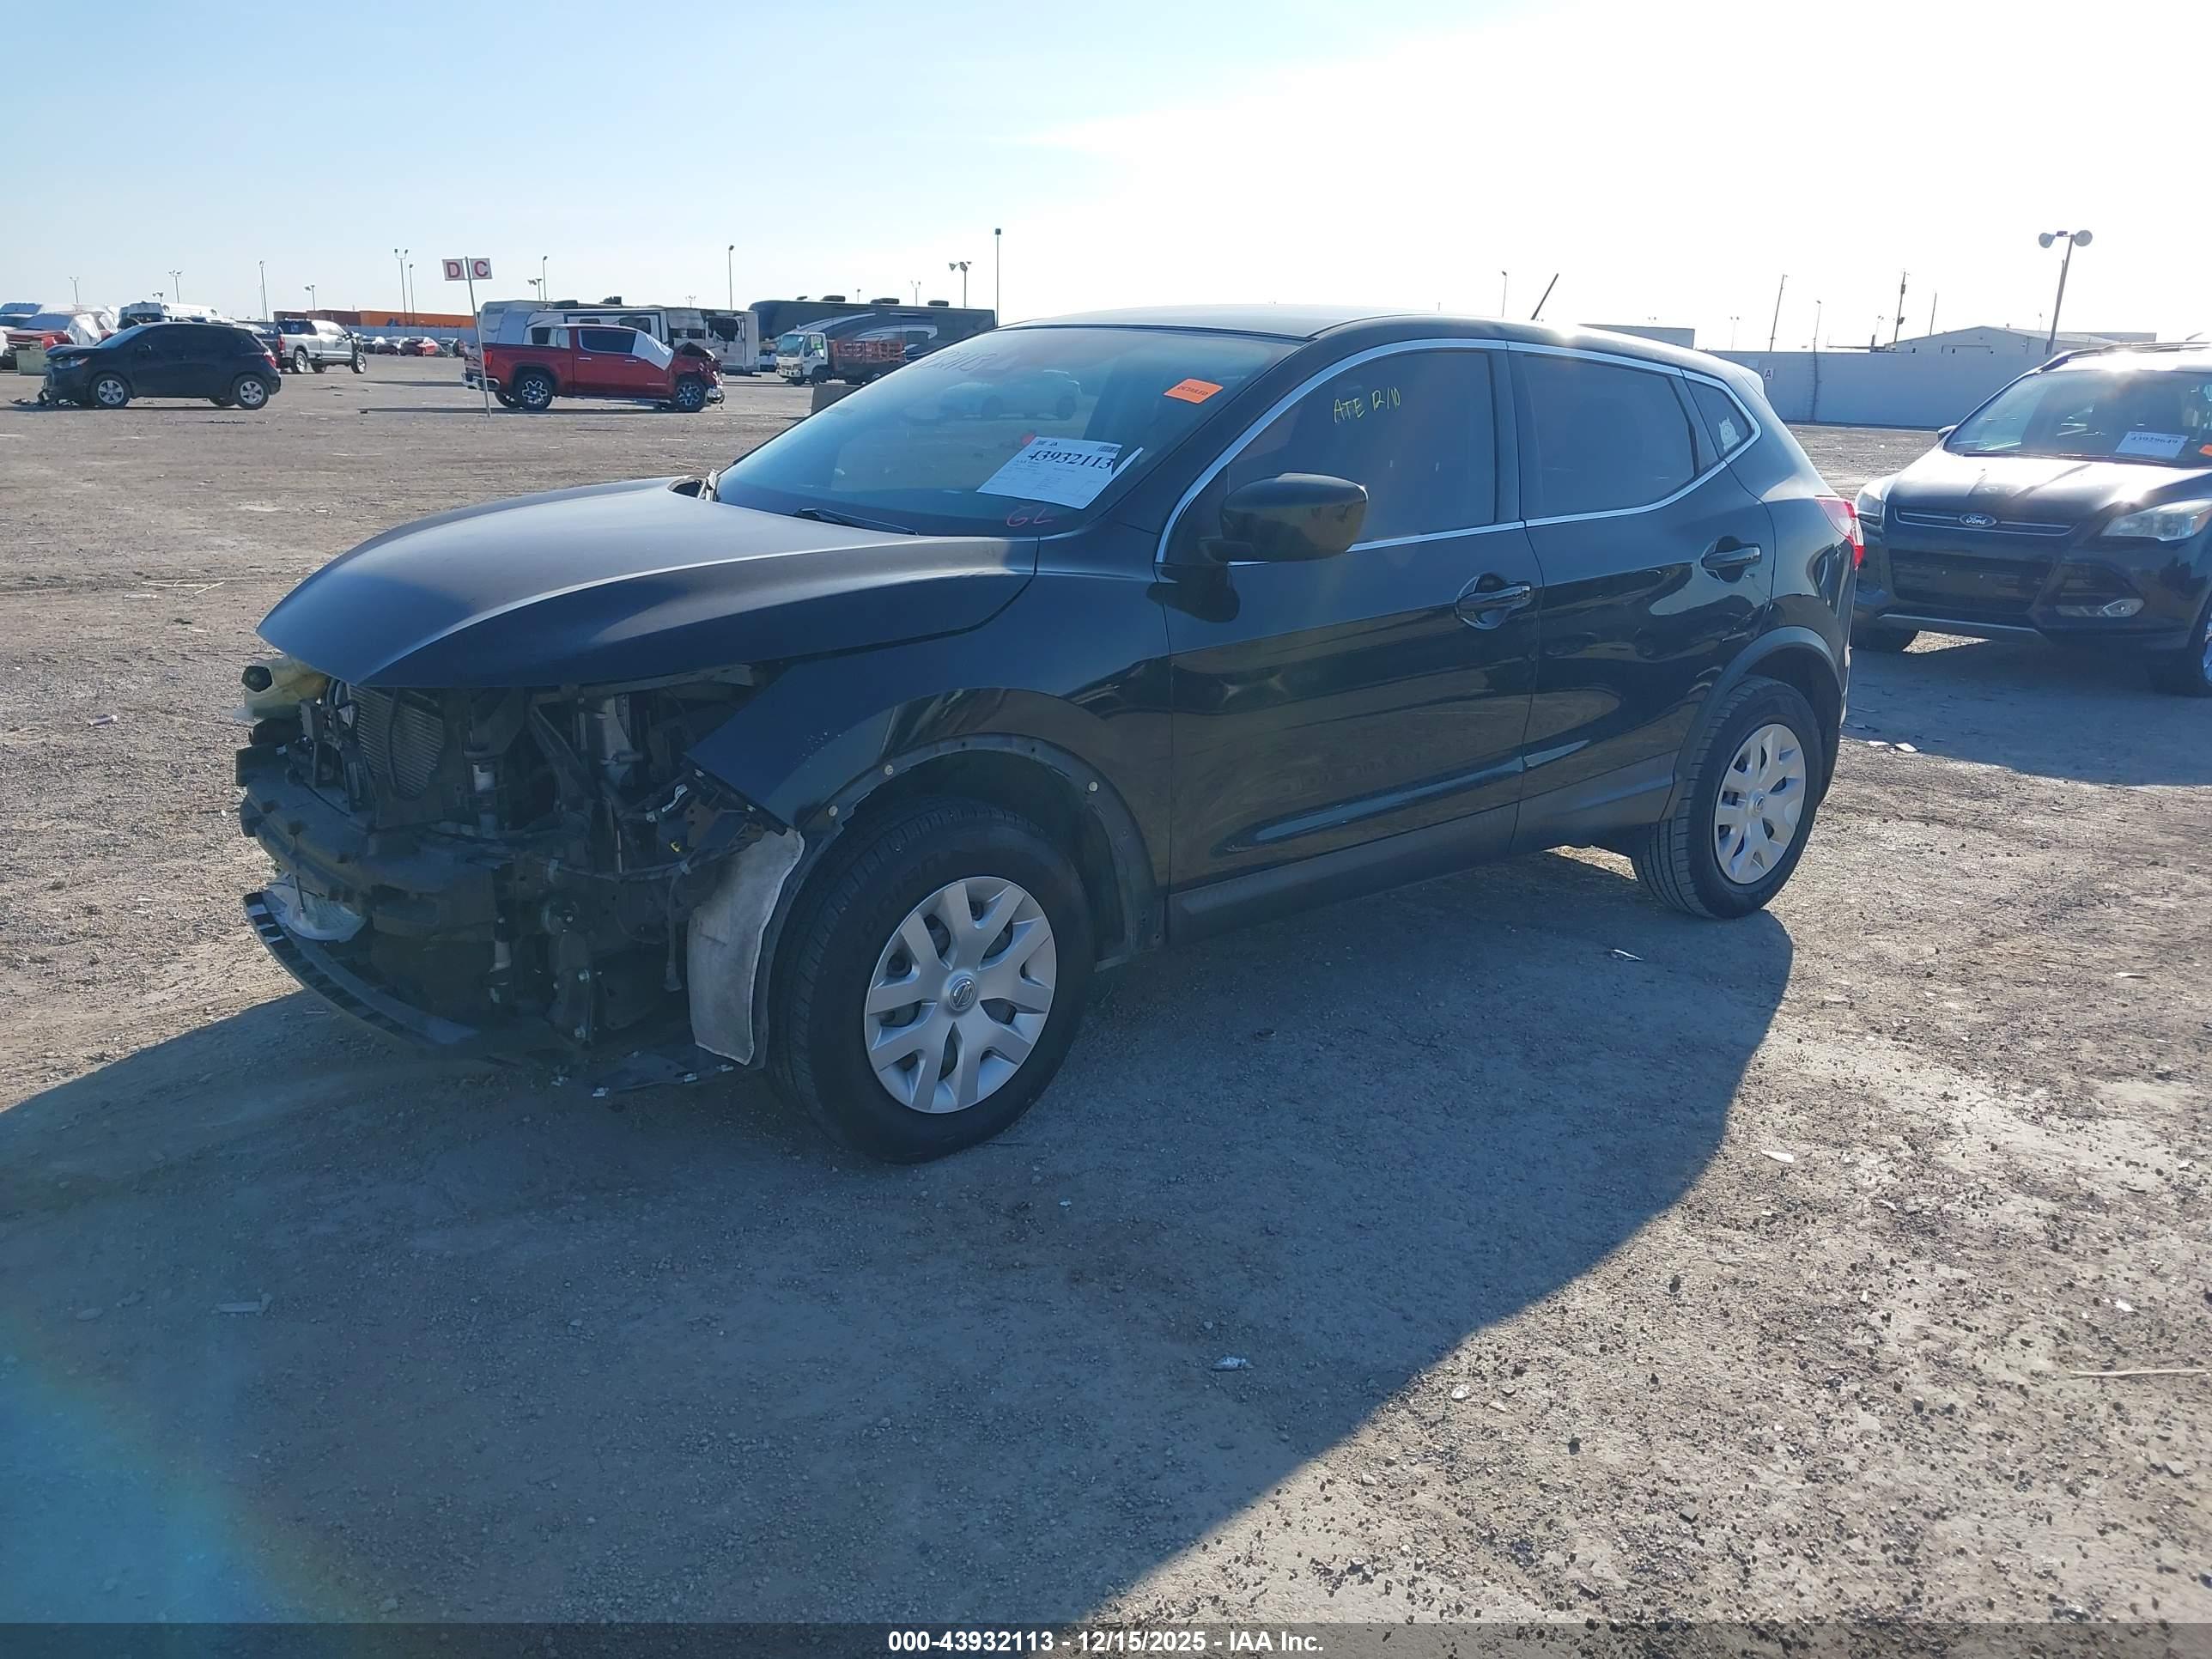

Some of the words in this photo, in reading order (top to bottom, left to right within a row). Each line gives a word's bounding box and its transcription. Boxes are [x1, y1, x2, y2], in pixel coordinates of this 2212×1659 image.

[447, 261, 461, 278] D
[474, 260, 488, 277] C
[1764, 369, 1771, 379] A
[1334, 398, 1365, 423] ATE
[1028, 449, 1115, 470] 43932113
[1966, 515, 1988, 525] Ford
